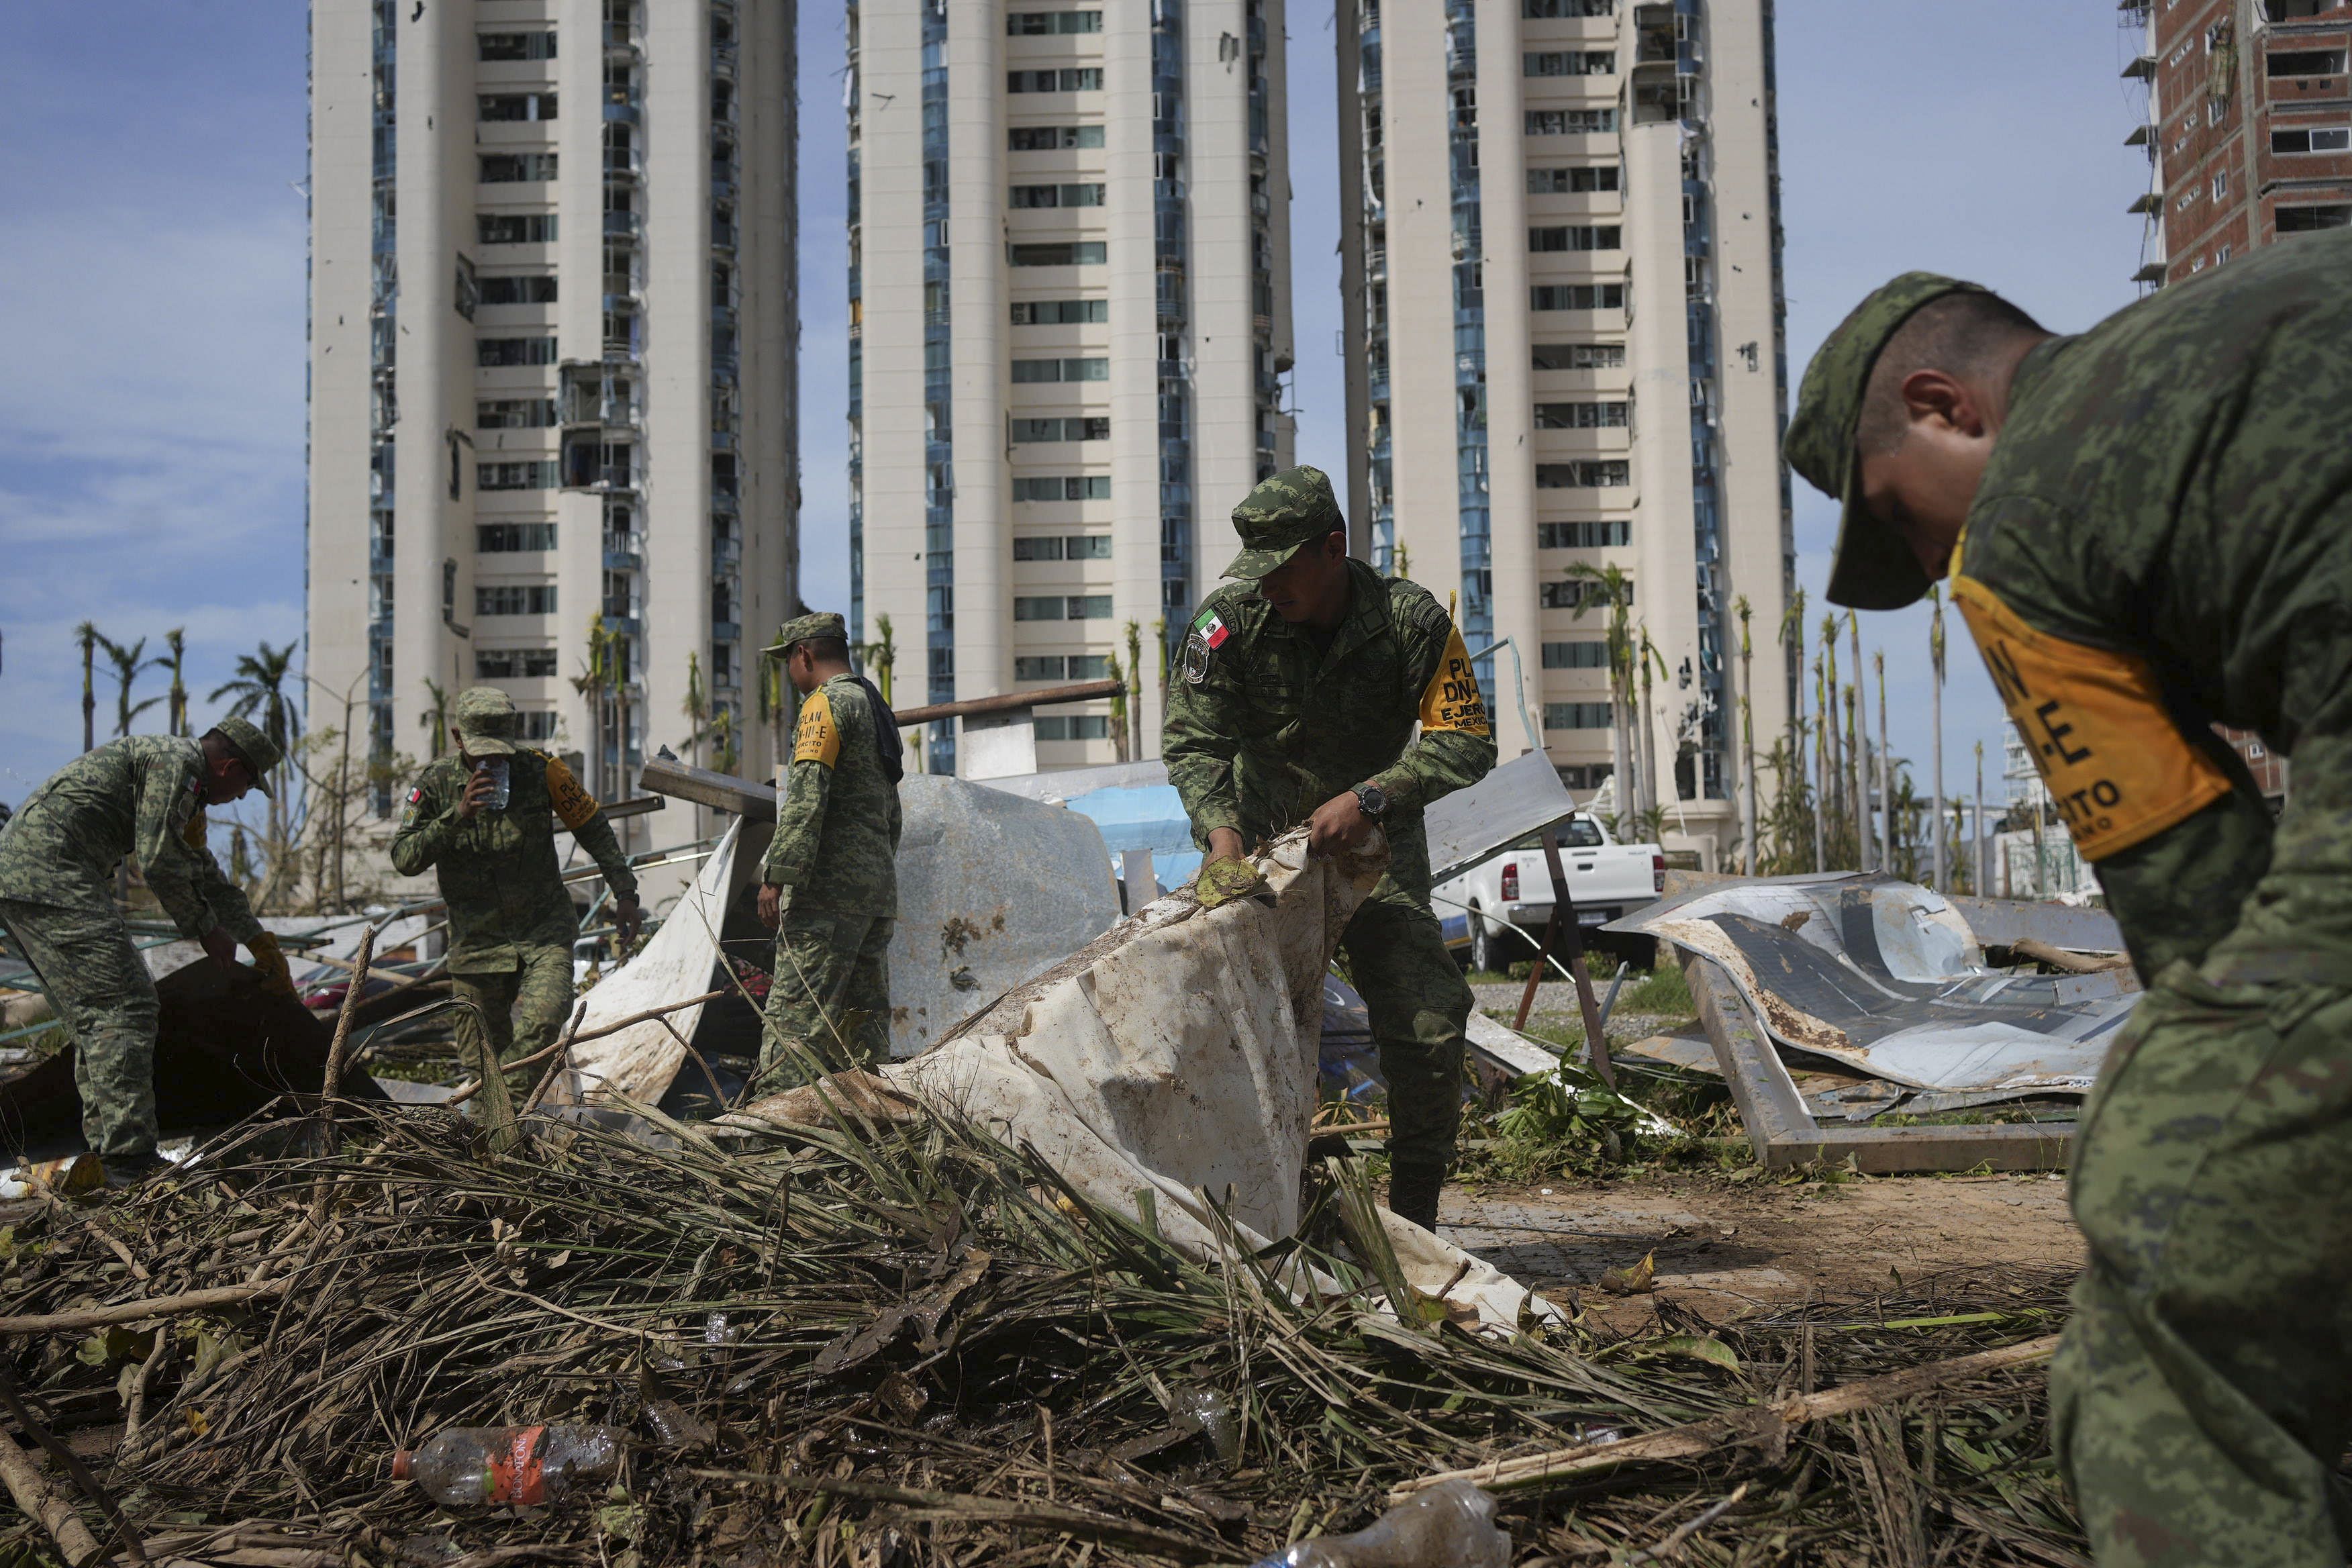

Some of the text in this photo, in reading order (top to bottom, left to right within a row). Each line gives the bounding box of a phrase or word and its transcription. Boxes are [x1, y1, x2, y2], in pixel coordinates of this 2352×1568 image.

[1217, 601, 1237, 634] MEXICO
[1983, 639, 2030, 707] N
[1454, 716, 1487, 728] MEXIC
